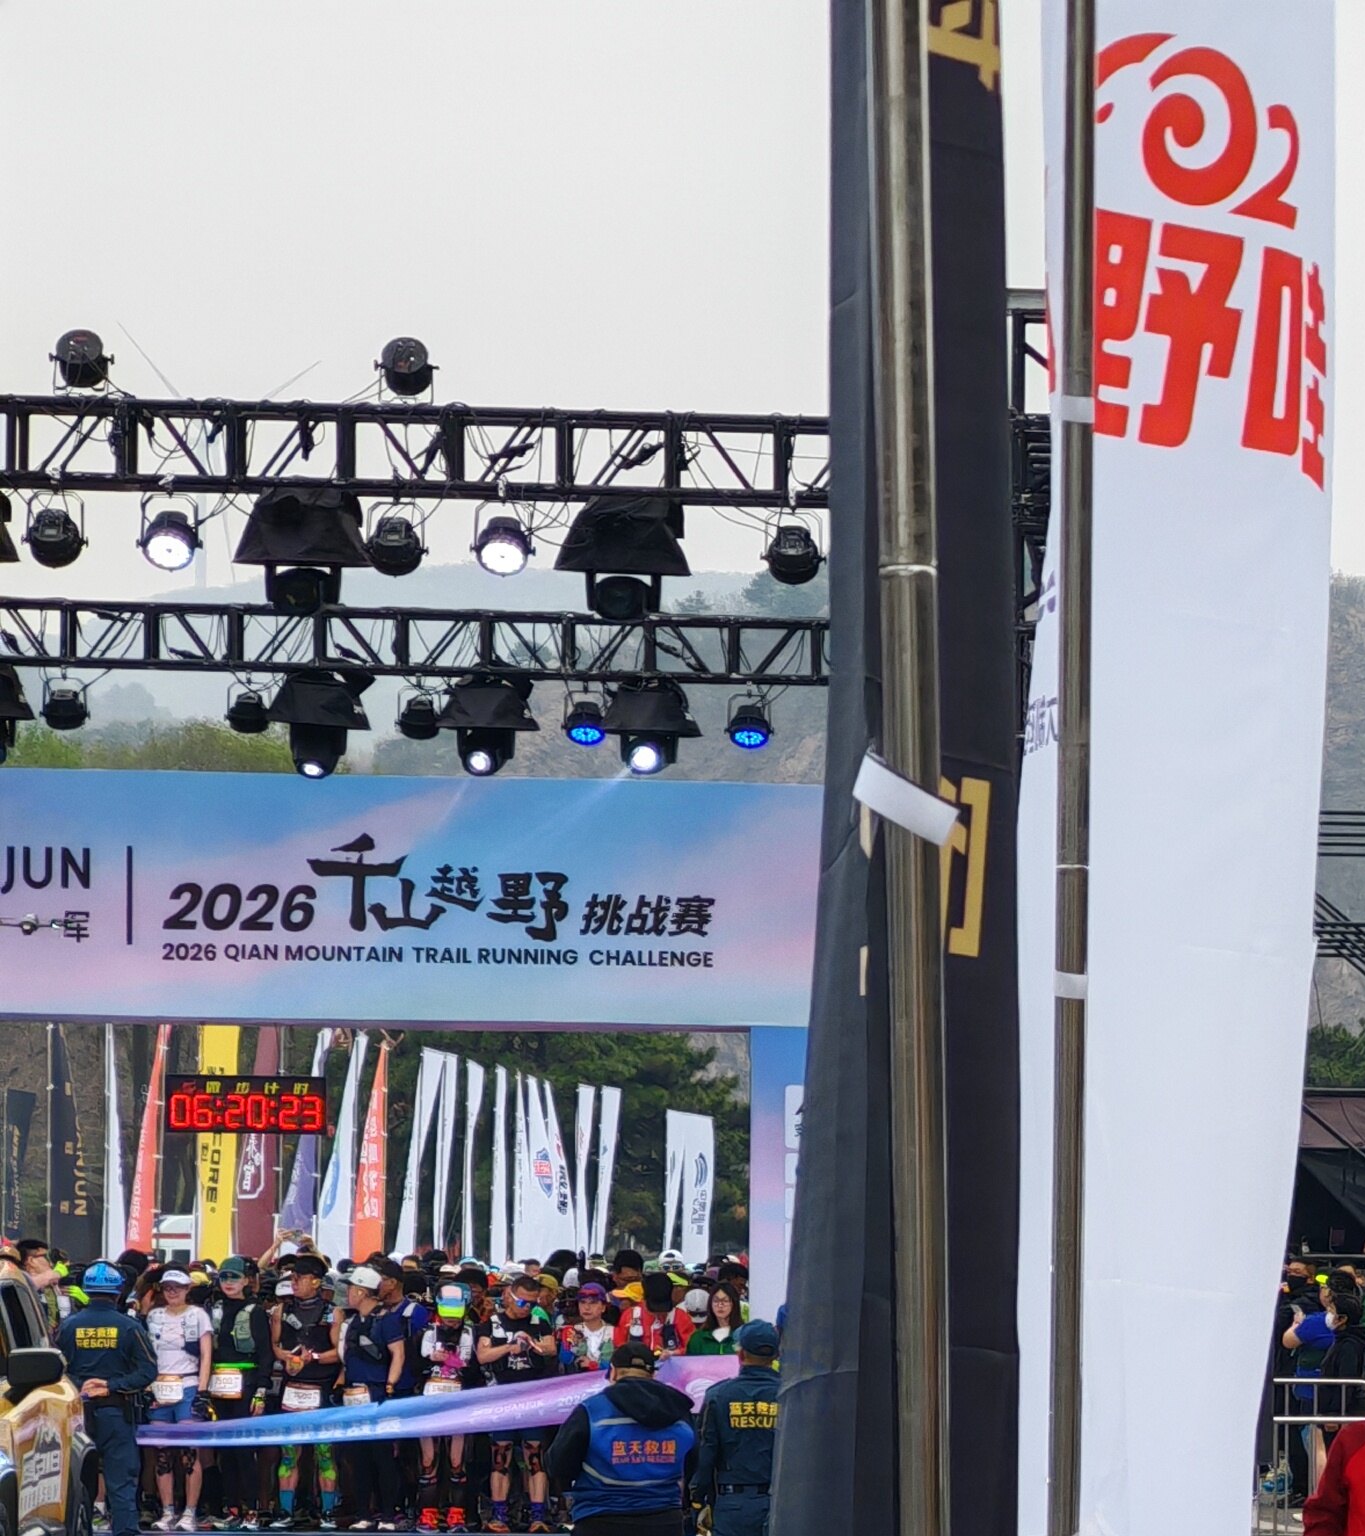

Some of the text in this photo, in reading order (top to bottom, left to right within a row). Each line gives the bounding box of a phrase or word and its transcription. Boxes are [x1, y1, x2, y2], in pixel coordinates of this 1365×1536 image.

[163, 883, 317, 931] 2026
[162, 943, 714, 967] 2026 QIAN MOUNTAIN TRAIL RUNNING CHALLENGE
[170, 1094, 323, 1131] 06:20:23
[75, 1339, 119, 1349] RESCUE
[730, 1416, 778, 1429] RESCU
[612, 1440, 677, 1457] 蓝天救援
